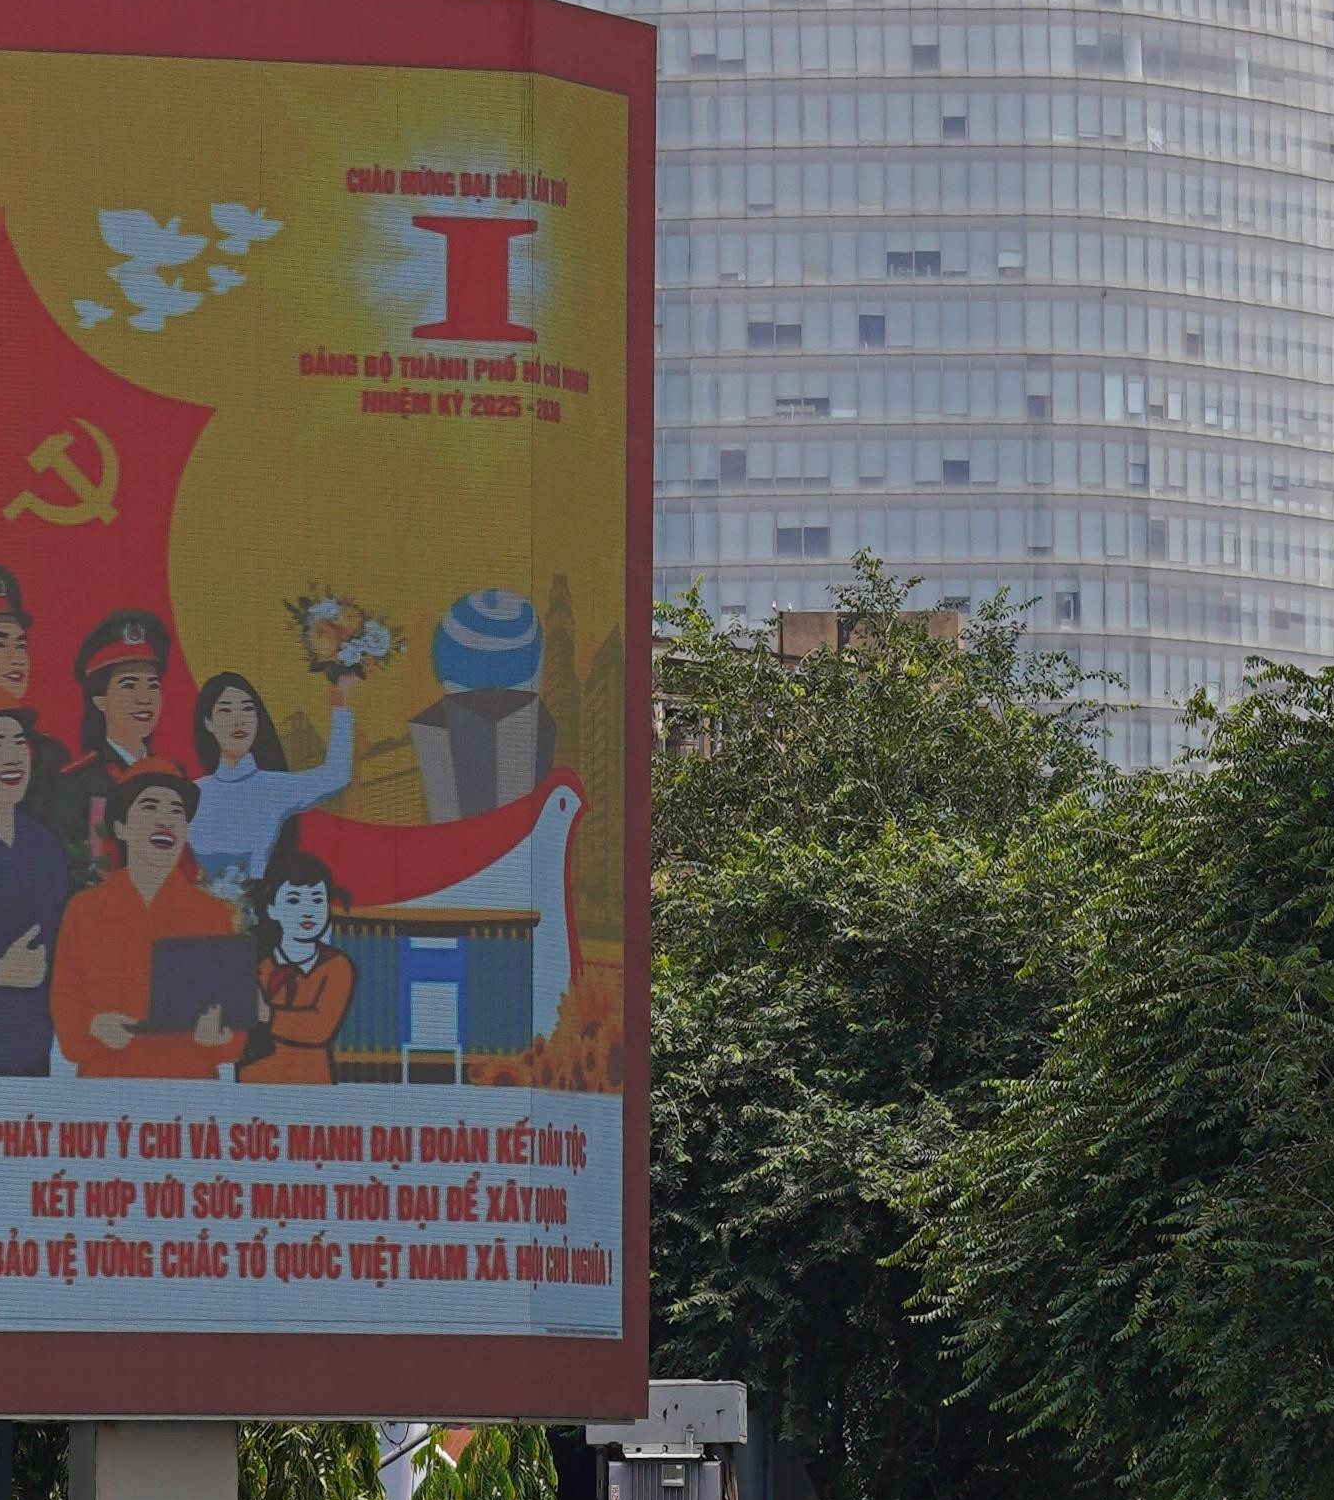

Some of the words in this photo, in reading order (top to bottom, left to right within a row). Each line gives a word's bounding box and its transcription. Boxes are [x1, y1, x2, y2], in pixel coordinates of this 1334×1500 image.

[346, 164, 396, 194] CHÀO
[398, 353, 467, 380] THÀNH
[473, 352, 517, 382] PHỐ
[470, 393, 523, 418] 2025
[58, 1121, 109, 1159] HUY
[116, 1114, 132, 1159] Ý
[139, 1114, 182, 1160] CHÍ
[188, 1115, 222, 1160] VÀ
[229, 1116, 280, 1161] SỨC
[287, 1124, 363, 1170] MẠNH
[370, 1126, 412, 1171] ĐẠI
[420, 1119, 489, 1164] ĐOÀN
[496, 1116, 536, 1165] KẾT
[538, 1122, 563, 1168] DÂN
[565, 1123, 587, 1176] TỘC
[31, 1168, 79, 1218] KẾT
[84, 1177, 137, 1226] HỢP
[143, 1173, 186, 1219] VỚI
[192, 1174, 243, 1220] SỨC
[250, 1182, 327, 1228] MẠNH
[334, 1175, 390, 1221] THỜI
[398, 1184, 440, 1230] ĐẠI
[446, 1171, 480, 1222] ĐỂ
[486, 1178, 533, 1223] XÂY
[535, 1184, 567, 1232] DỰNG
[46, 1232, 78, 1286] VỆ
[84, 1233, 154, 1278] VỮNG
[161, 1227, 229, 1279] CHẮC
[235, 1227, 269, 1279] TỔ
[274, 1230, 342, 1283] QUỐC
[348, 1235, 403, 1289] VIỆT
[409, 1243, 468, 1281] NAM
[474, 1238, 509, 1281] XÃ
[516, 1238, 542, 1291] HỘI
[546, 1234, 569, 1285] CHỦ
[571, 1241, 606, 1287] NGHĨA
